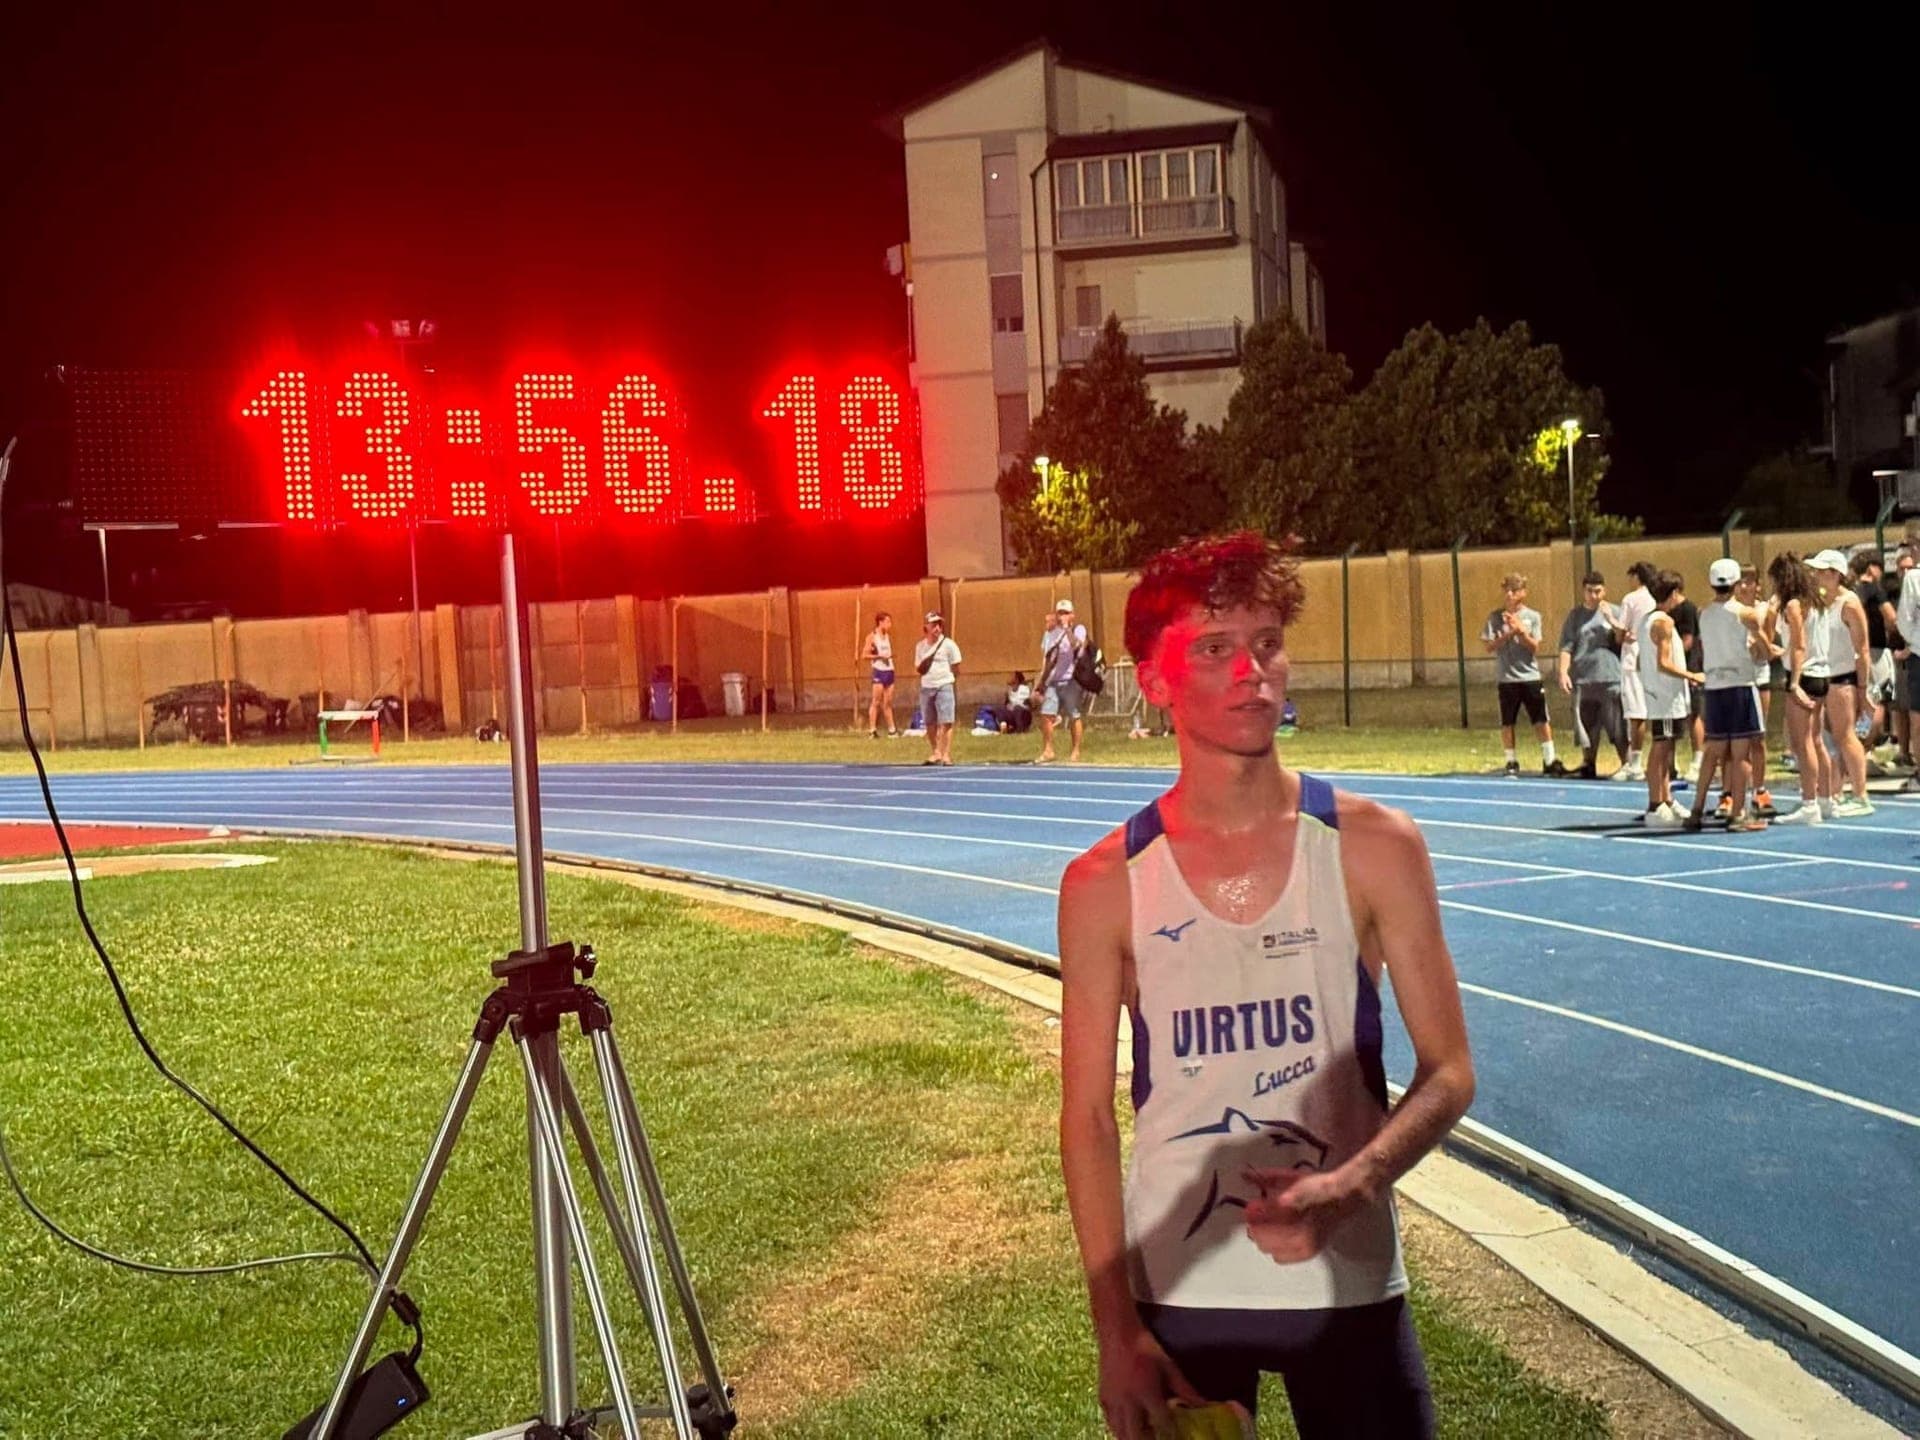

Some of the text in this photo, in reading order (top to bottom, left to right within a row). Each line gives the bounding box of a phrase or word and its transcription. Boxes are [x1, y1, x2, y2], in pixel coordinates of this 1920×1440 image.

[241, 370, 905, 520] 13:56.18
[1173, 994, 1315, 1058] VIRTUS
[1253, 1055, 1316, 1097] Lucca
